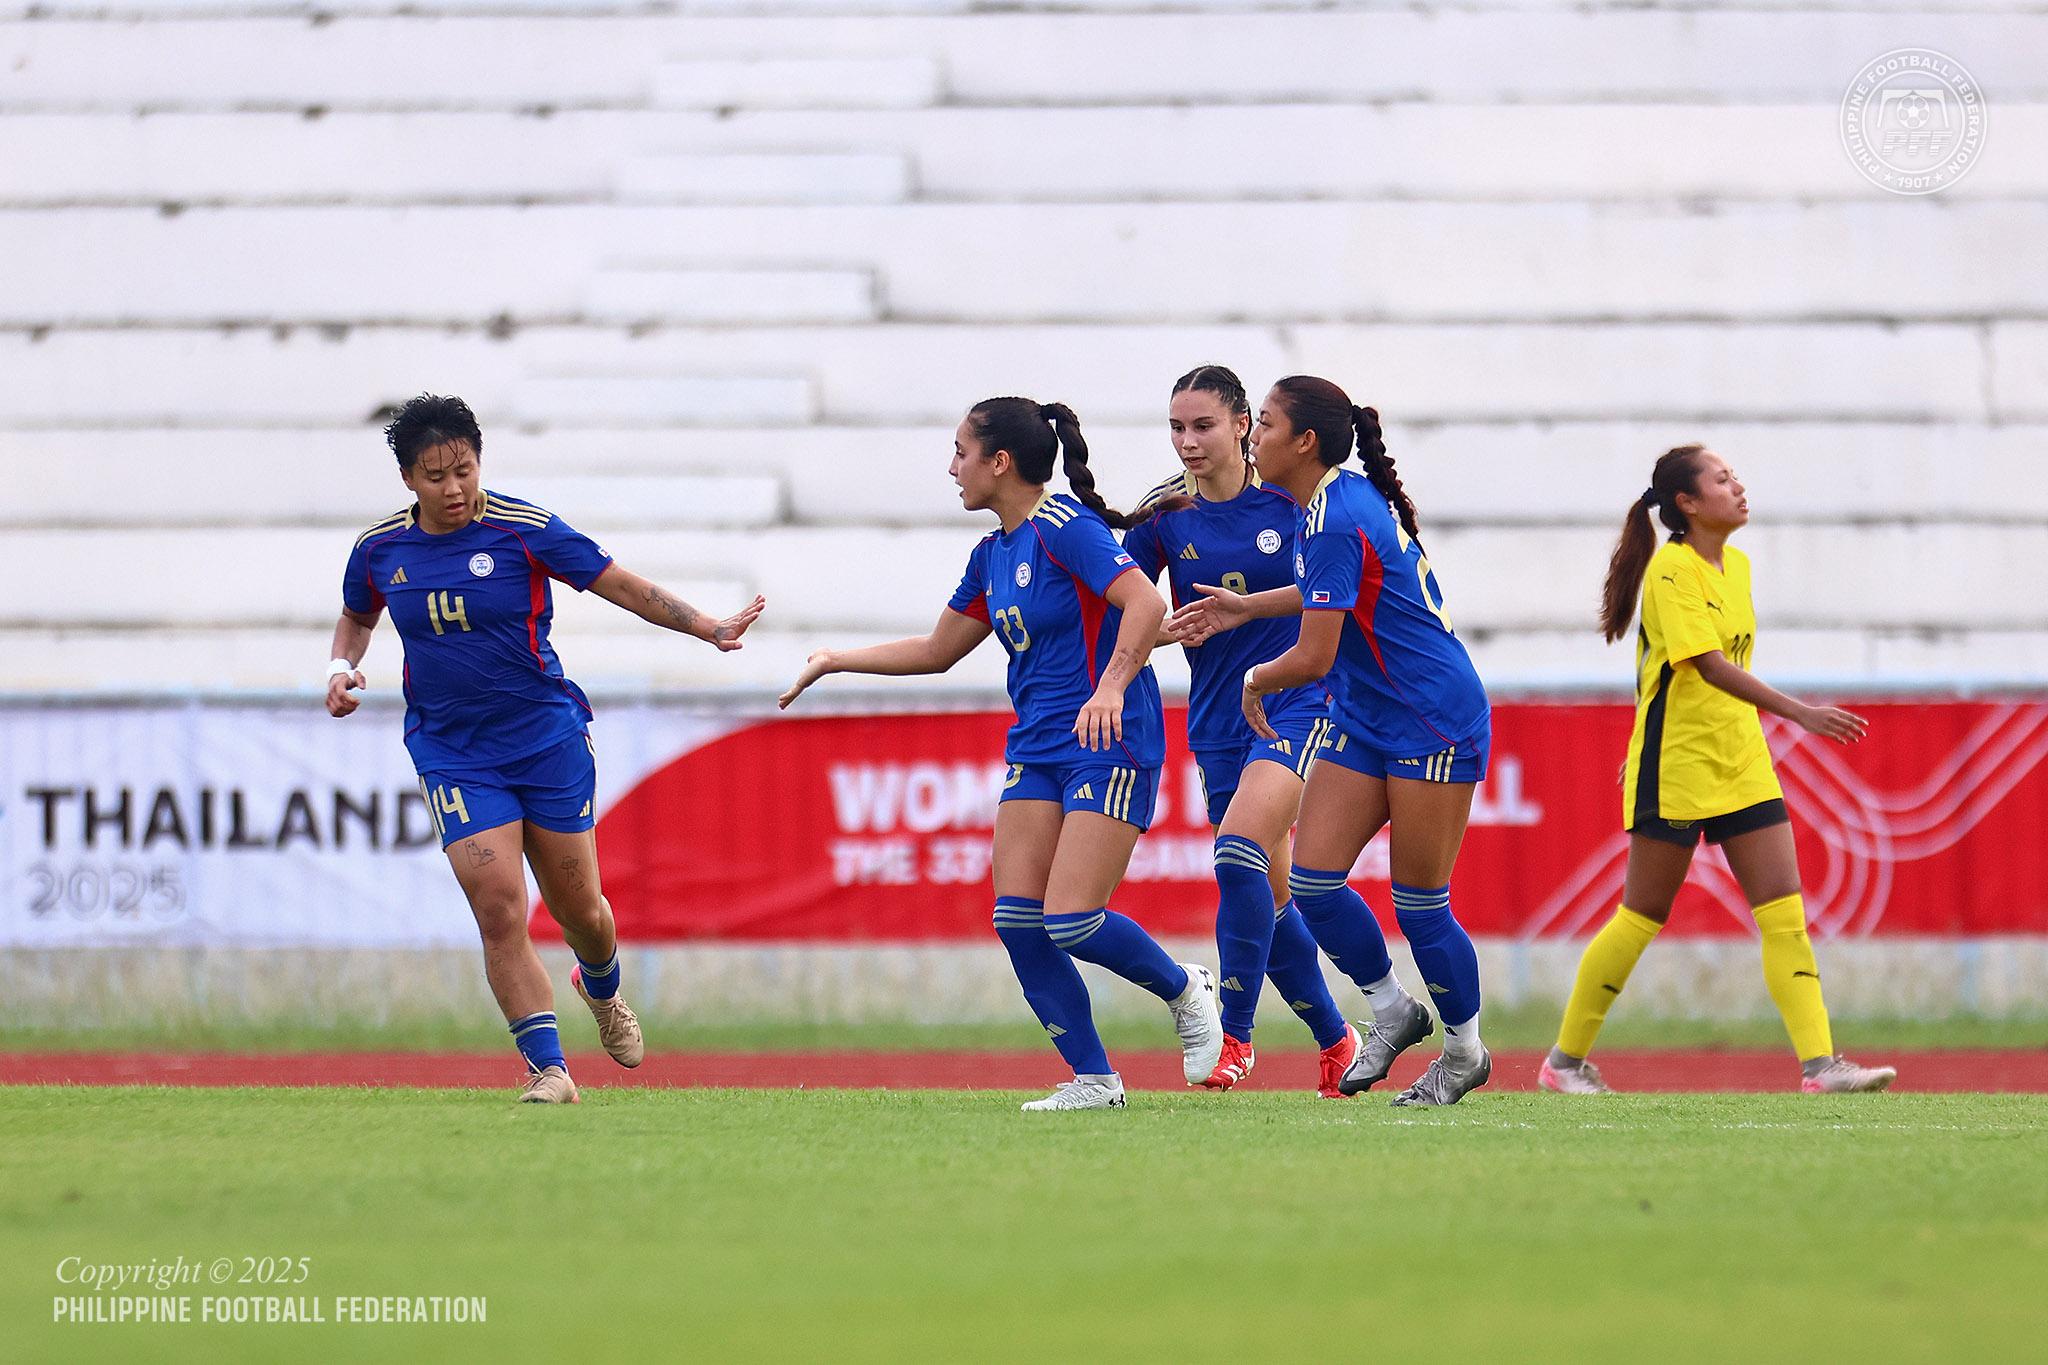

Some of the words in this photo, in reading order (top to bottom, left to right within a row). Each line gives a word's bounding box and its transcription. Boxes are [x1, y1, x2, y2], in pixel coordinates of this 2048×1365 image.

[427, 590, 471, 635] 14
[26, 787, 438, 850] THAILAND
[432, 783, 470, 834] 14
[27, 863, 187, 920] 2025
